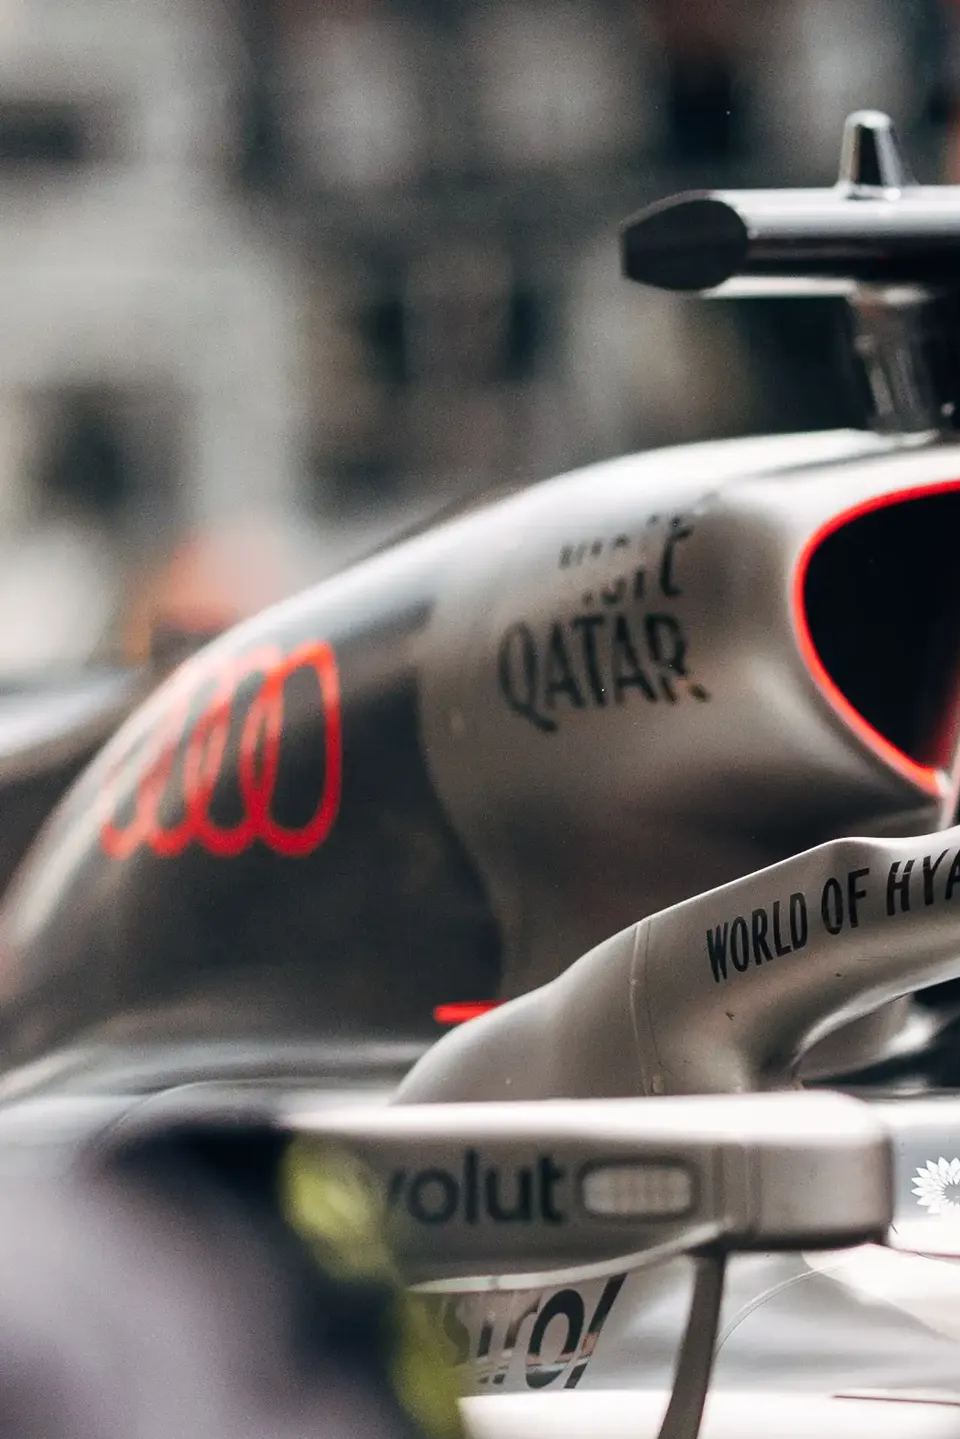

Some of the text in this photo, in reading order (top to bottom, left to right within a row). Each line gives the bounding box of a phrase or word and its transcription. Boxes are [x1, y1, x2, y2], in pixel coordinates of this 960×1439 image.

[497, 612, 709, 732] QATAR
[706, 892, 808, 983] WORLD
[820, 867, 871, 935] OF
